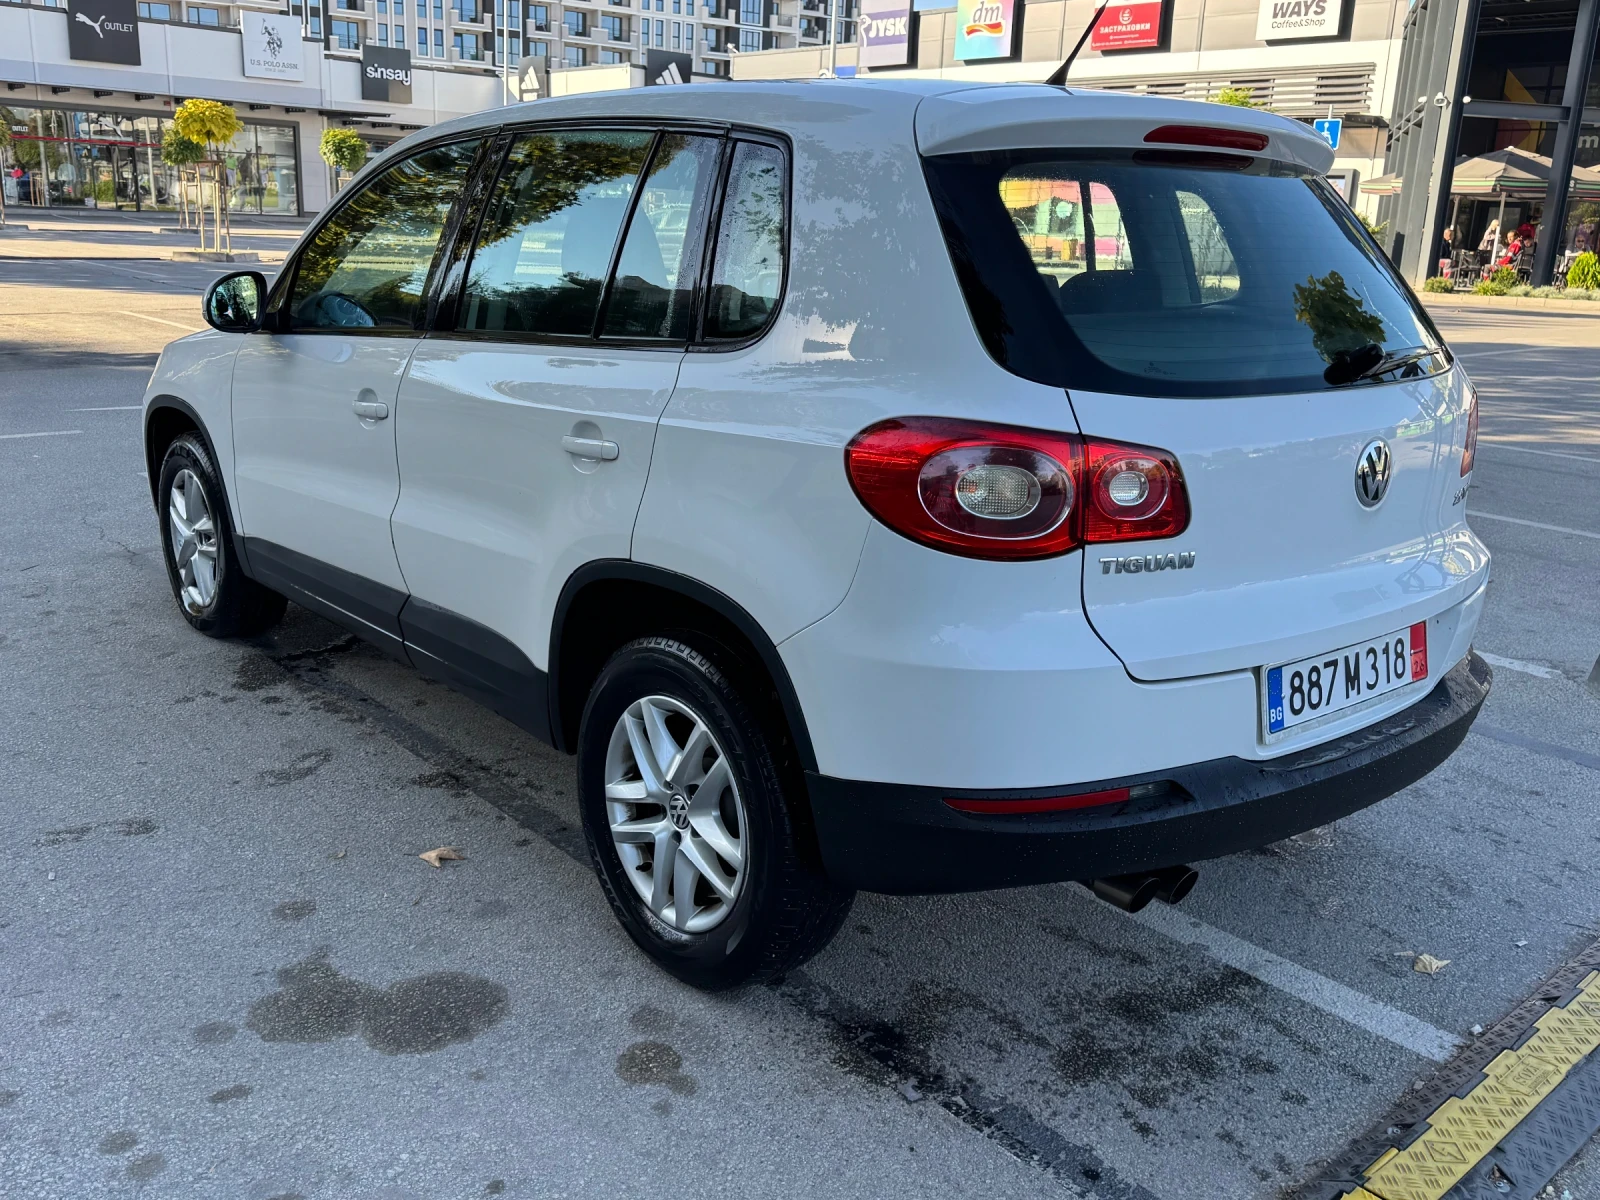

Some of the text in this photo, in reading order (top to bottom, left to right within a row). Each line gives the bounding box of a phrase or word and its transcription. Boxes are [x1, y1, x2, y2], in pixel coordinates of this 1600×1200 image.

[972, 1, 1000, 23] dm
[1272, 0, 1327, 19] WAYS
[104, 22, 134, 32] OUTLET
[868, 17, 907, 38] JYSK
[1100, 23, 1151, 33] ЗАСТРАХОВКИ
[1272, 19, 1326, 29] Coffee&Shop
[281, 62, 299, 70] ASSN.
[366, 63, 411, 86] sinsay
[1099, 551, 1195, 575] TIGUAN
[1270, 706, 1283, 723] BG
